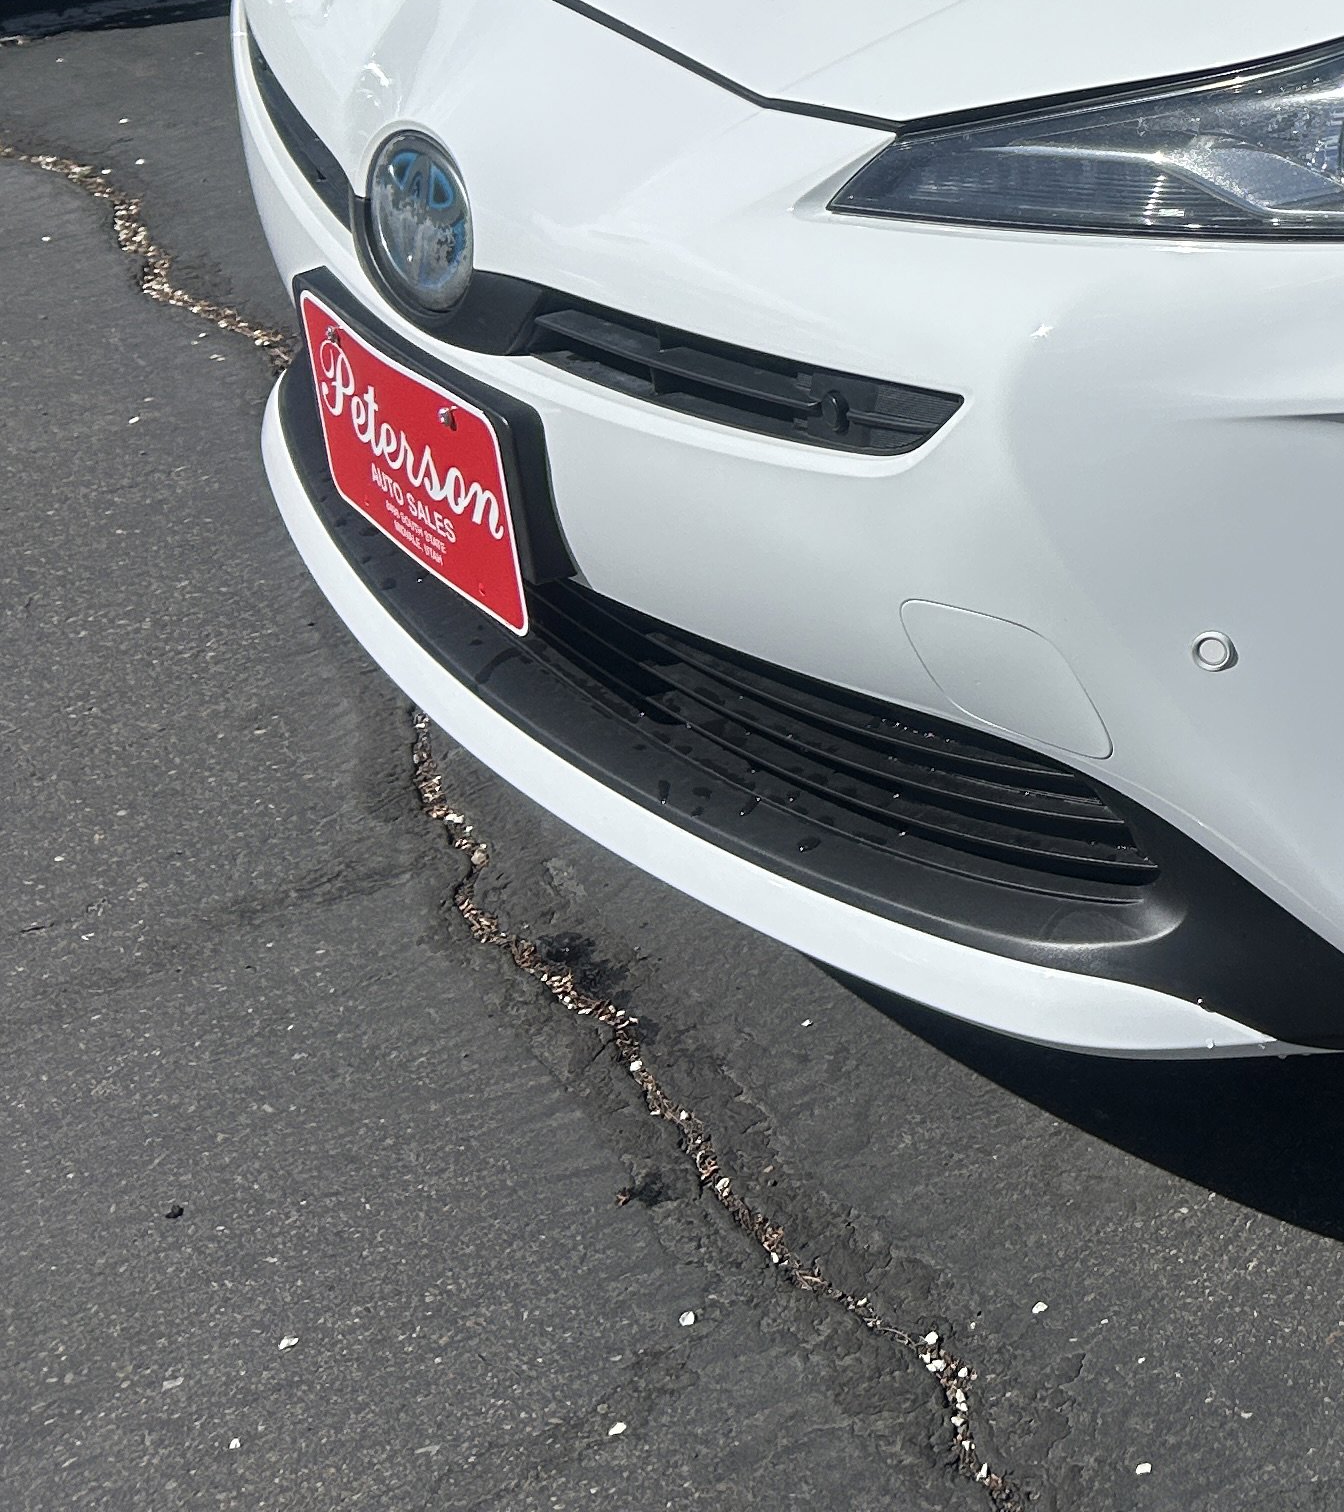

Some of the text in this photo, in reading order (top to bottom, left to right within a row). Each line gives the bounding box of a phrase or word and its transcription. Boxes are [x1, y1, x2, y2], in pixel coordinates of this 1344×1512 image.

[320, 339, 504, 540] Peterson
[371, 462, 404, 506] AUTO
[406, 492, 456, 543] SALES
